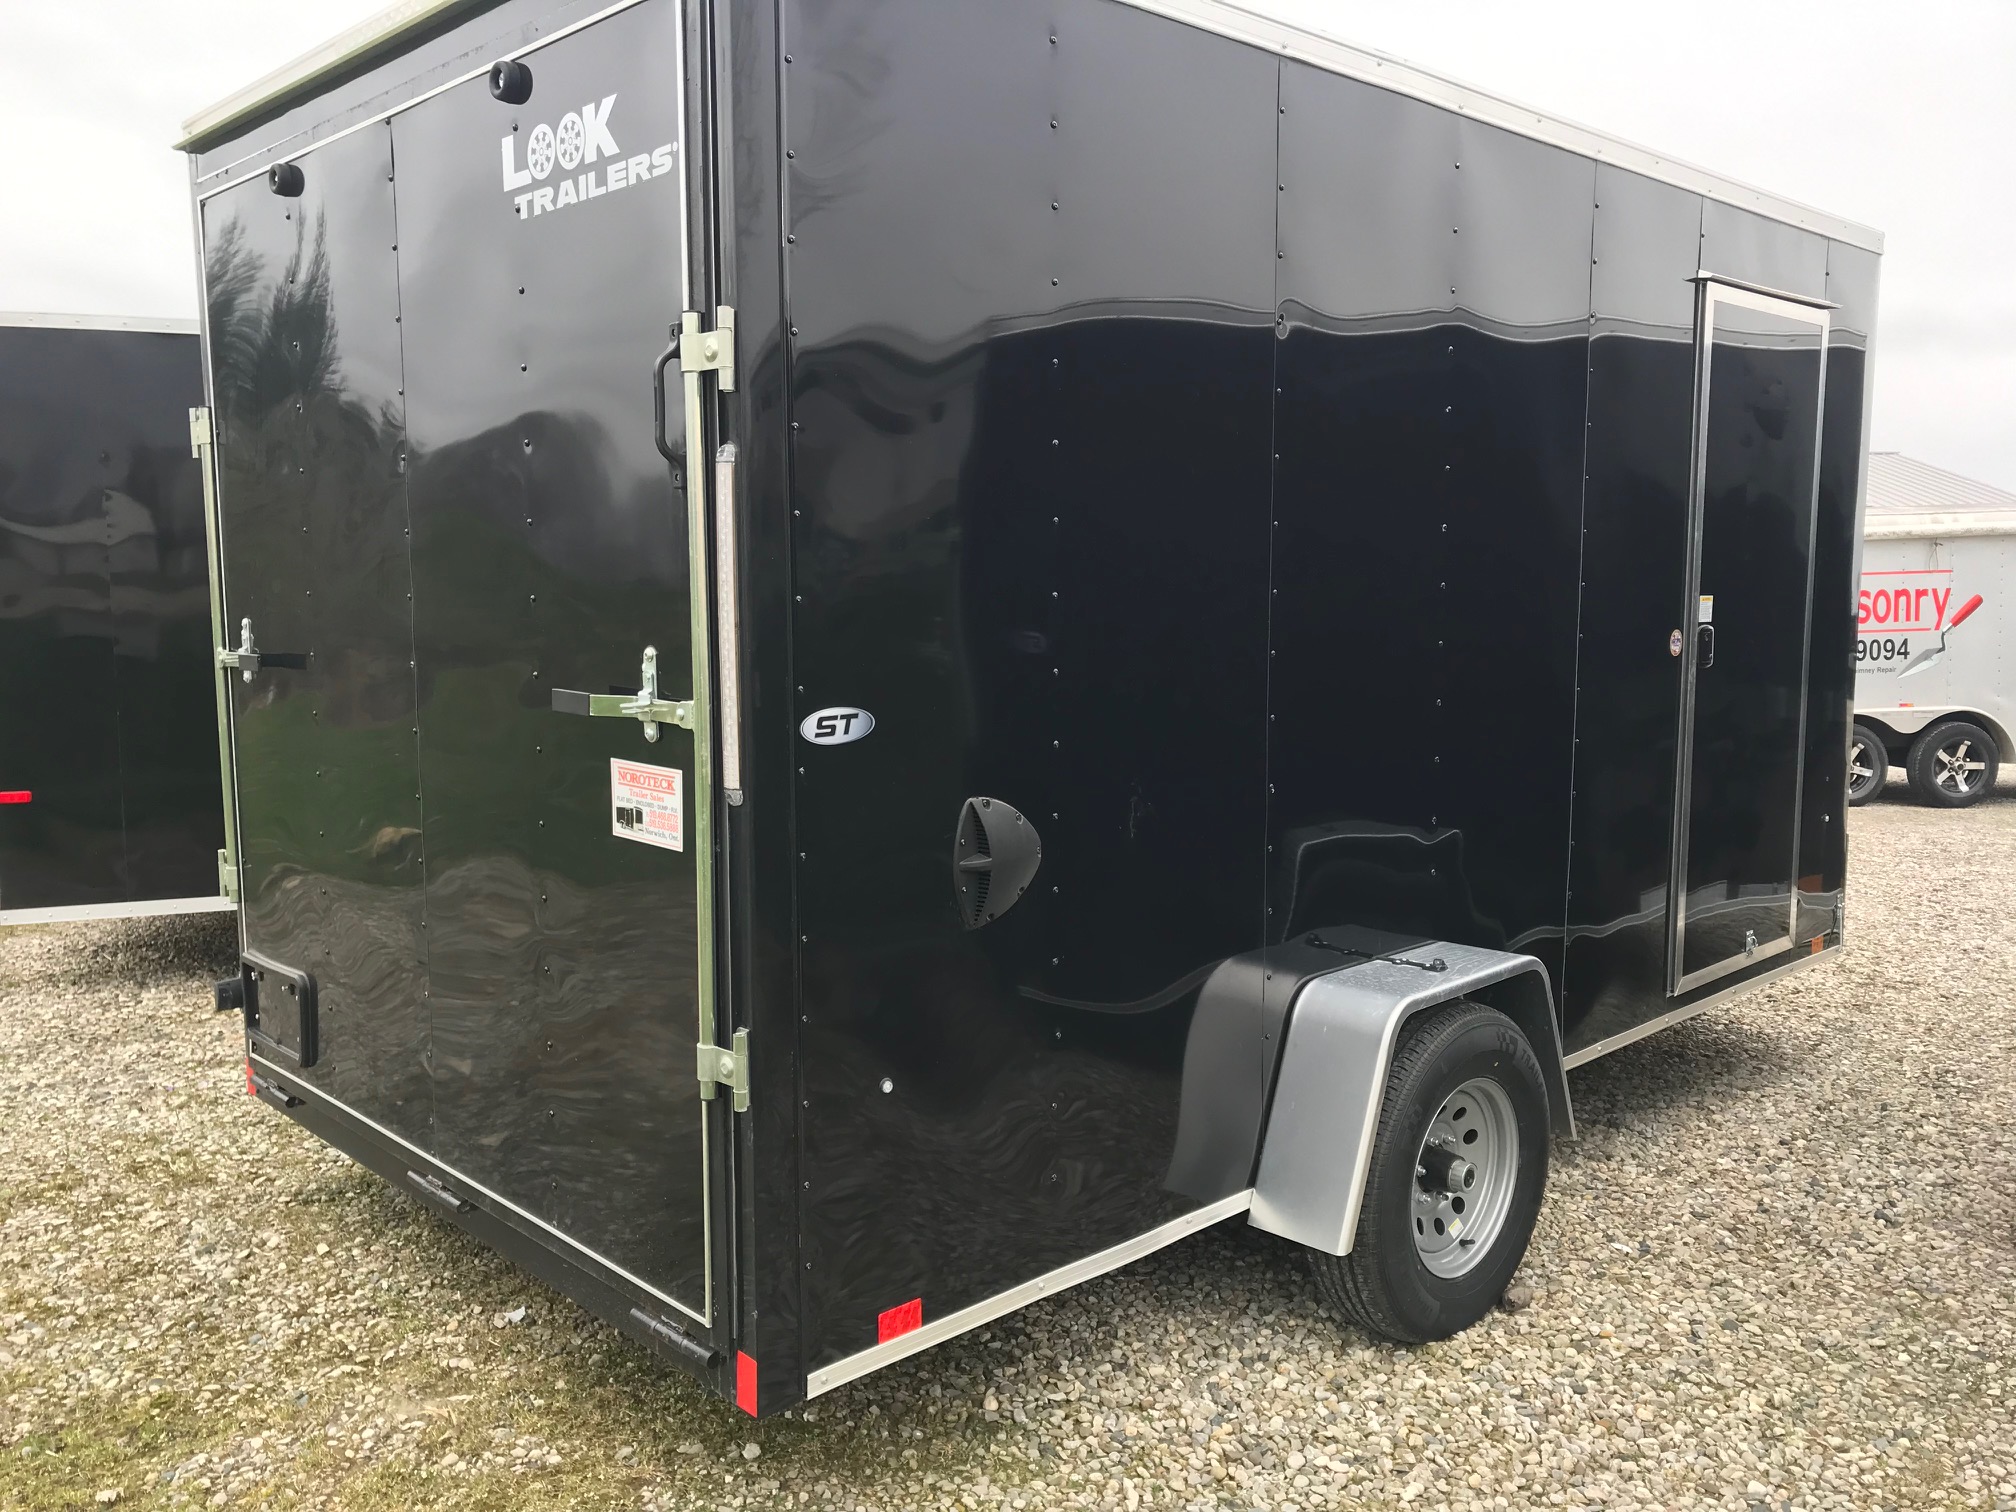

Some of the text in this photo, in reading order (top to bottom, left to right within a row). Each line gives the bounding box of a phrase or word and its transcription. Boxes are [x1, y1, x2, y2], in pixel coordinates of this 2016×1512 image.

[501, 93, 621, 193] LOOK
[514, 143, 673, 220] TRAILERS
[1857, 588, 1952, 631] sonry
[1856, 638, 1910, 661] 9094
[1876, 666, 1897, 674] Repair
[814, 712, 860, 738] ST
[617, 770, 676, 791] NOROTECK
[629, 788, 665, 803] Trailer Sales
[645, 827, 668, 840] Norwich,
